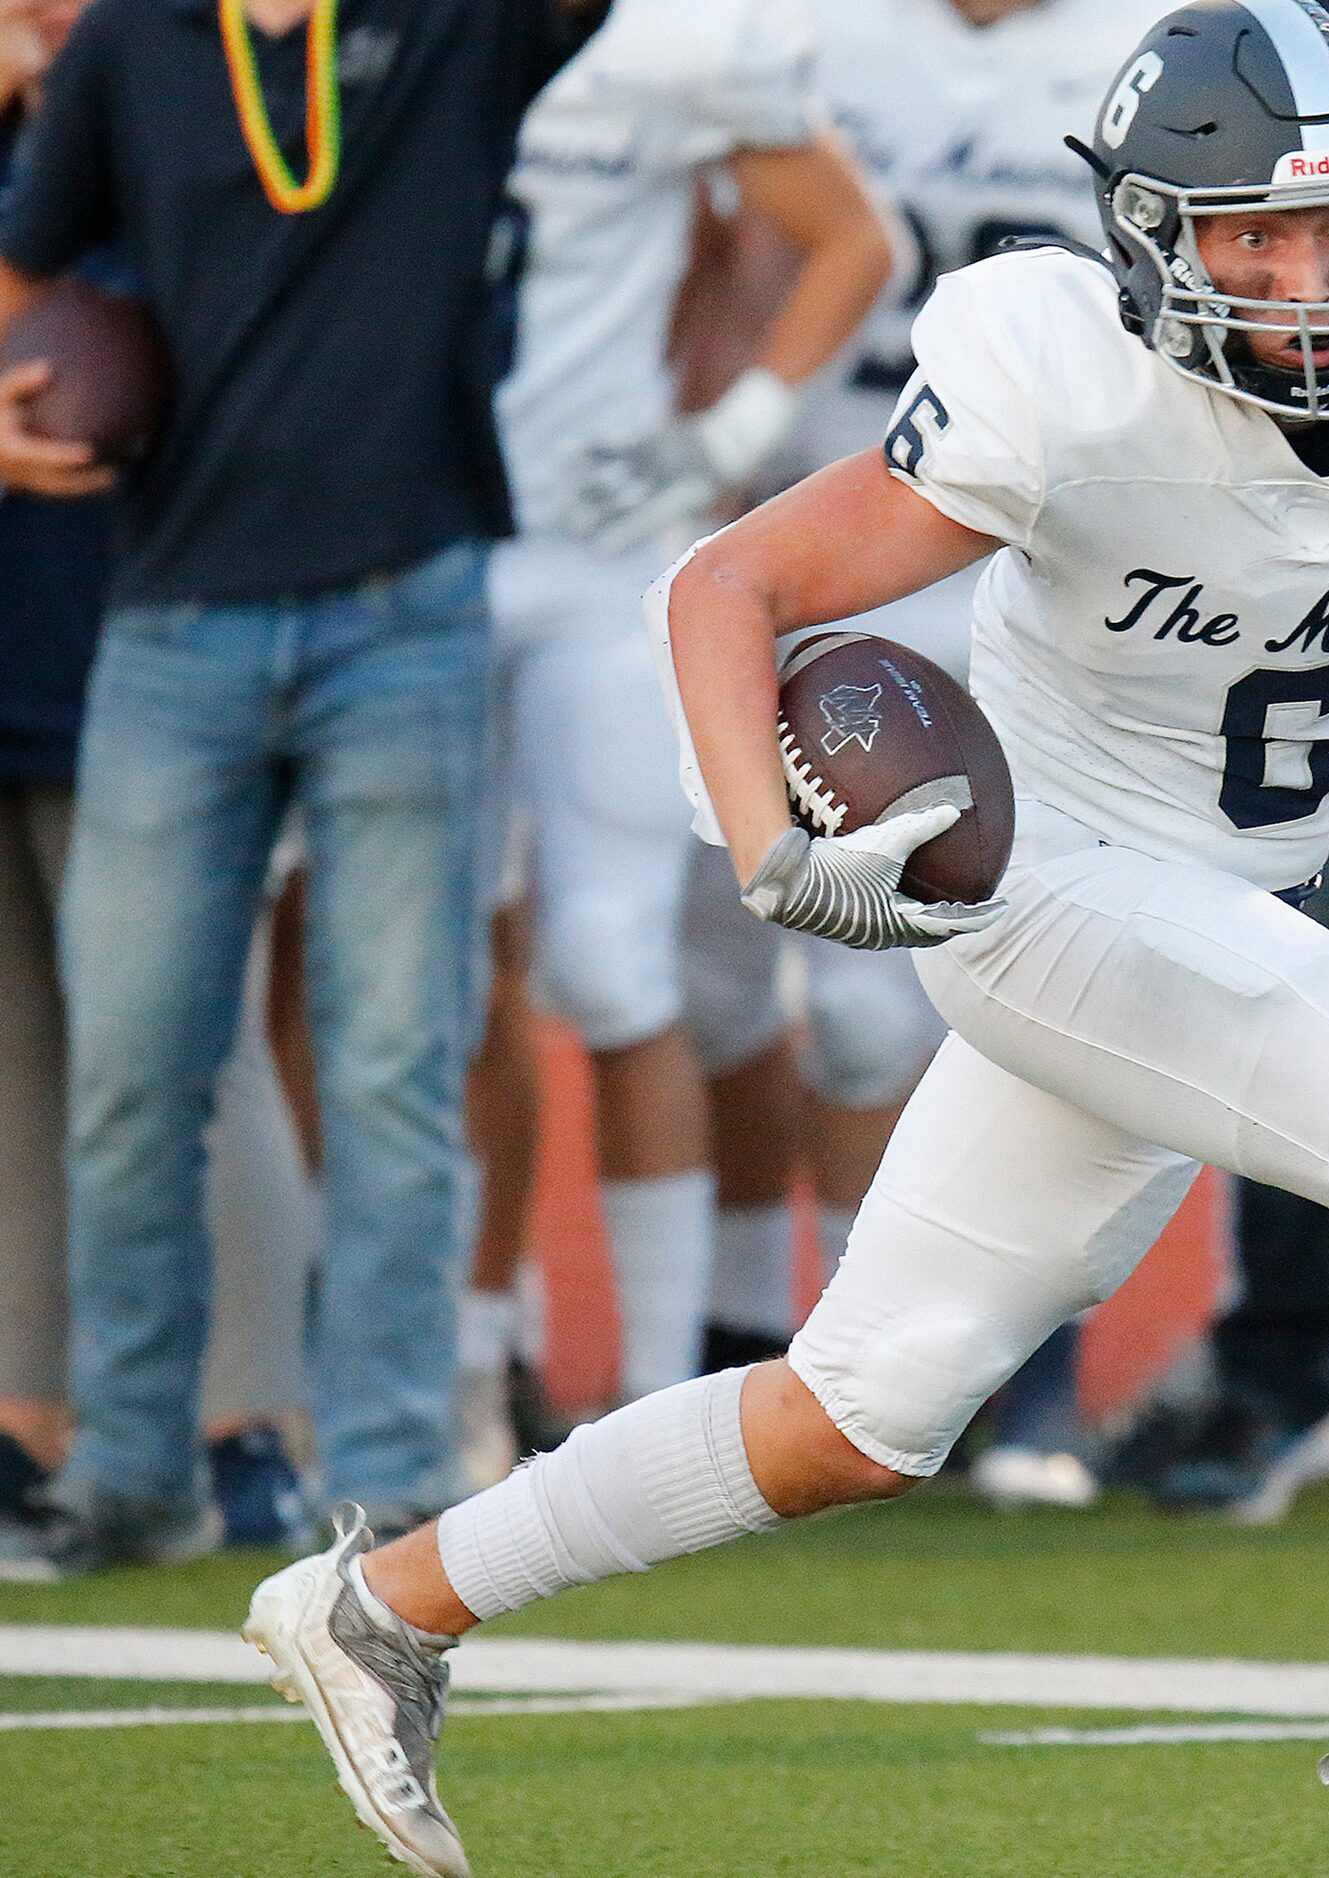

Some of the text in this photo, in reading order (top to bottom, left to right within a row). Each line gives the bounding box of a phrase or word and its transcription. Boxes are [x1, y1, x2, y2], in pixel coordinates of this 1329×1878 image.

[1102, 50, 1166, 150] 6
[884, 384, 950, 478] 6
[1105, 568, 1240, 646] The
